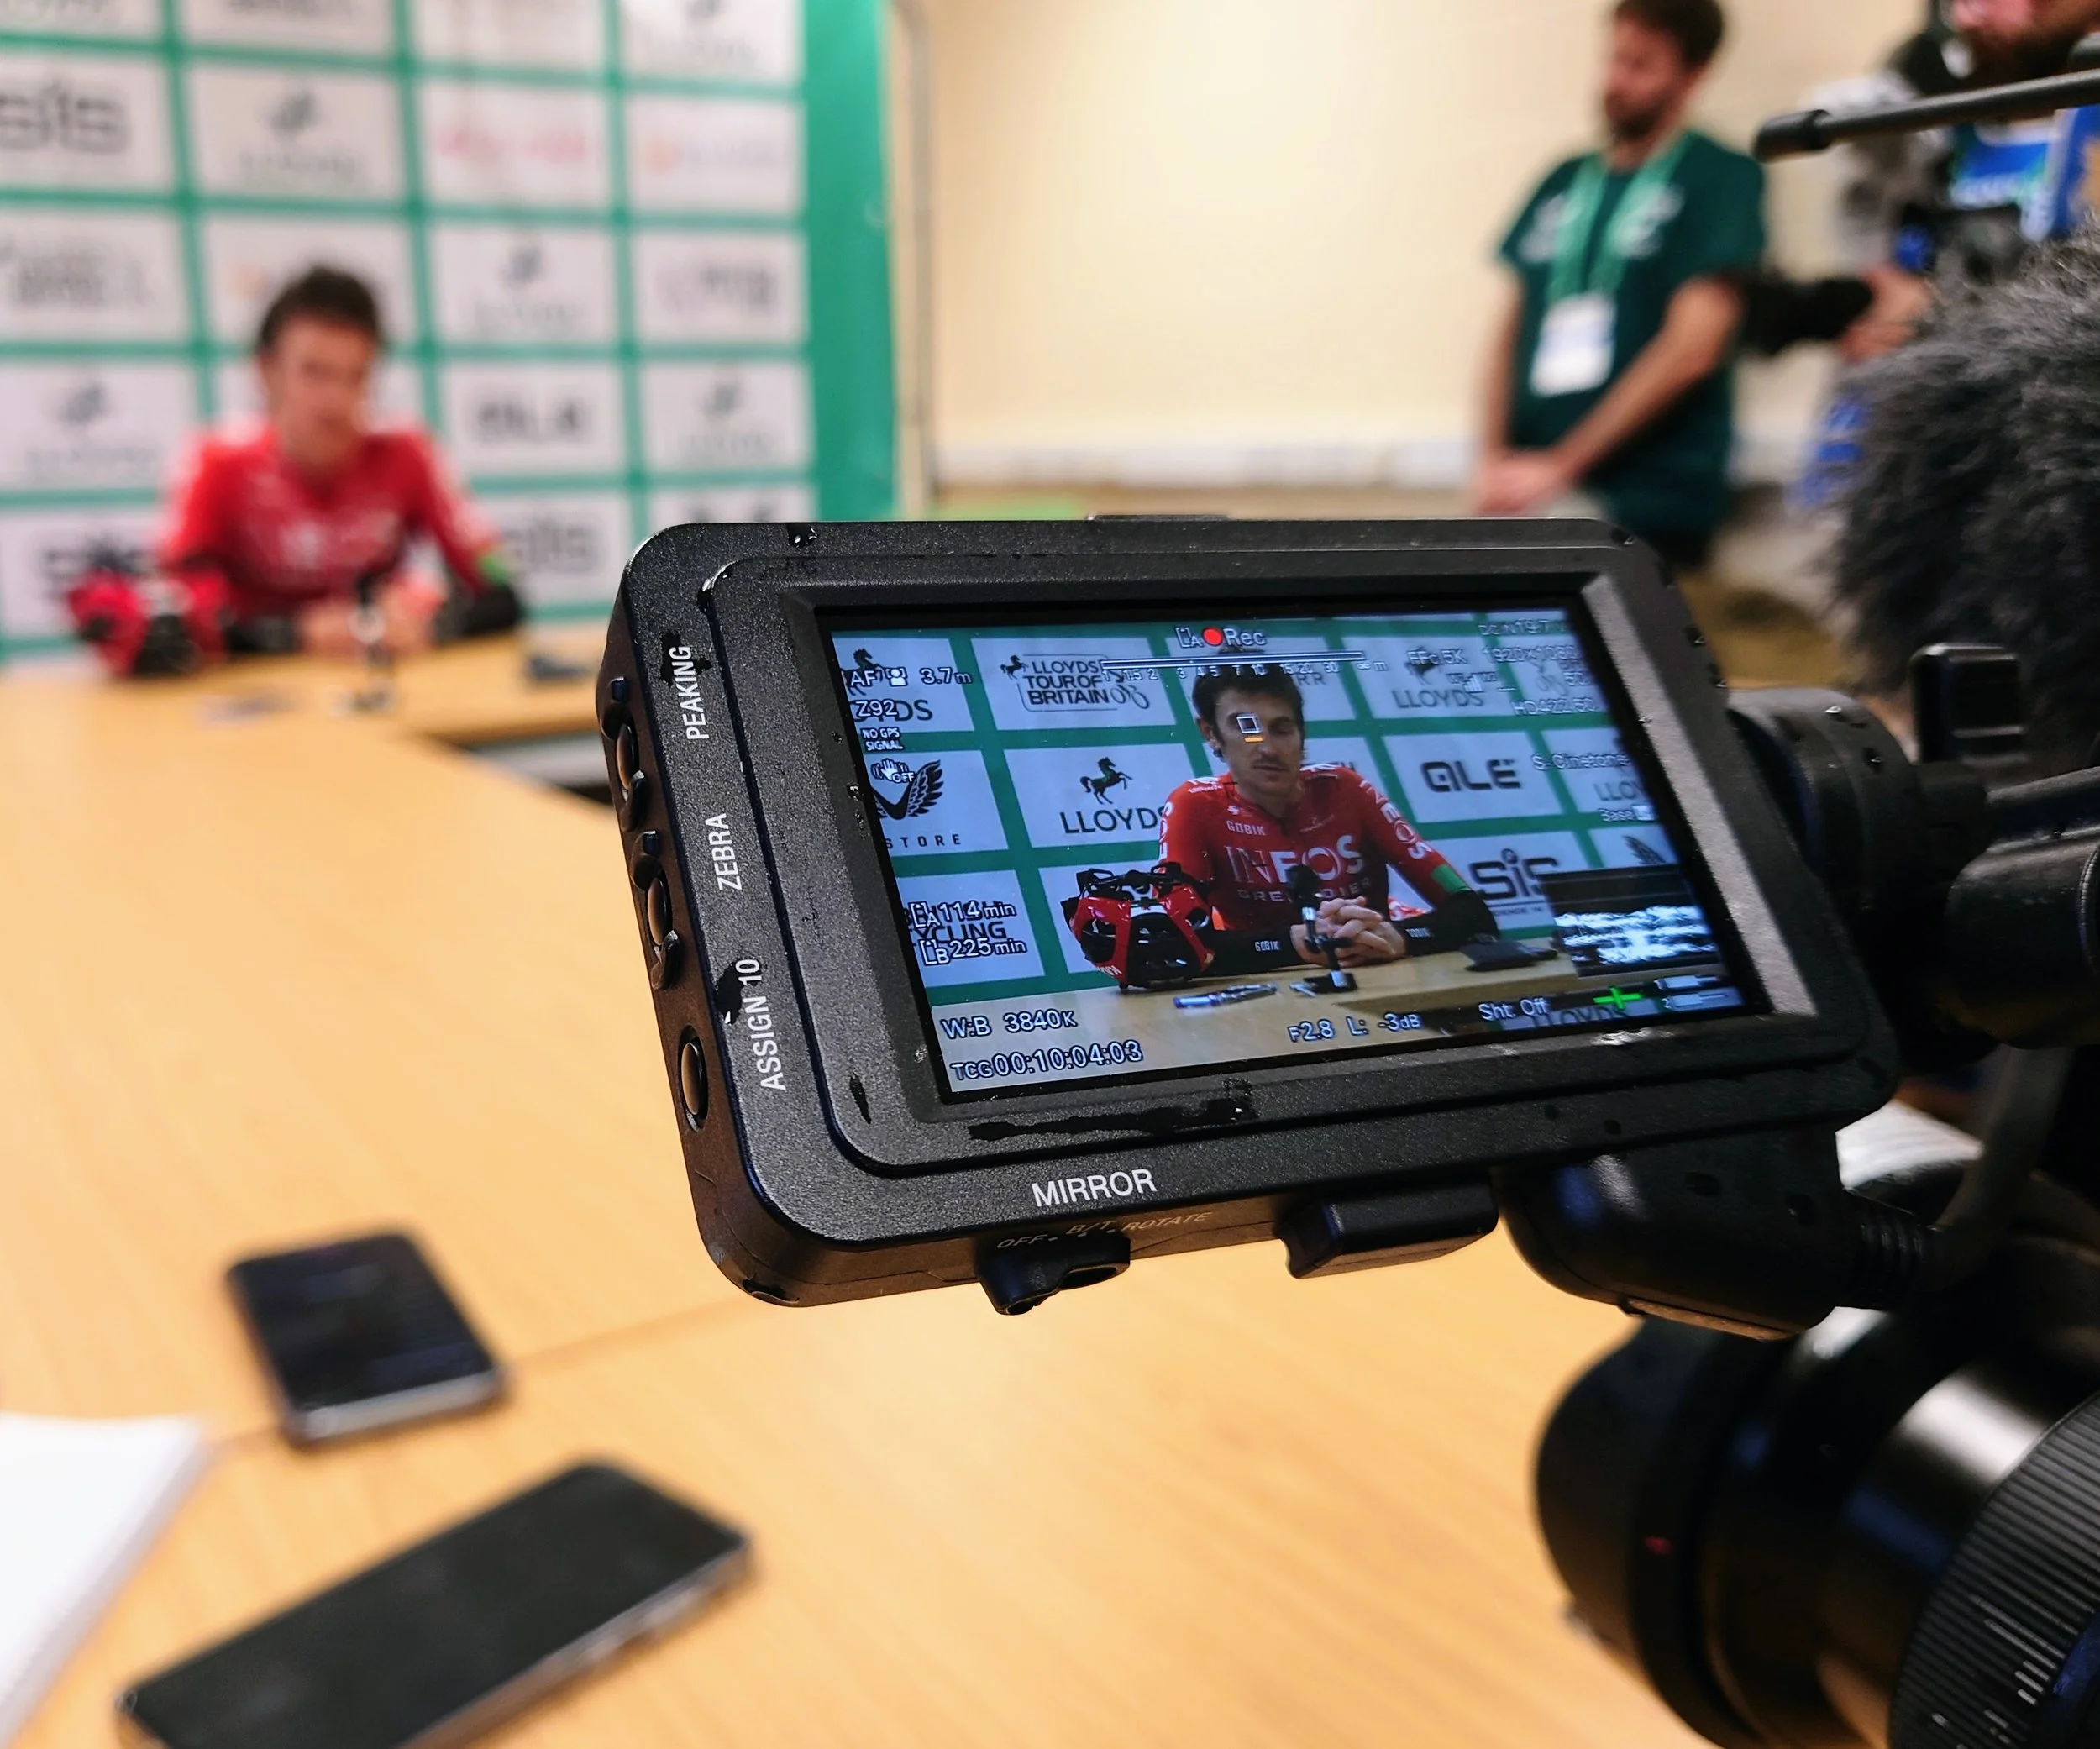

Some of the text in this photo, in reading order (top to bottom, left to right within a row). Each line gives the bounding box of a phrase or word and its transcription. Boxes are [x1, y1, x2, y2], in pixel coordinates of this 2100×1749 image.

[1222, 628, 1266, 647] Rec
[1032, 660, 1099, 675] LLOYDS
[1148, 668, 1158, 680] 2
[1177, 667, 1186, 679] 3
[1210, 666, 1221, 677] 5
[850, 670, 876, 686] AF
[1022, 675, 1103, 689] TOUR OF
[669, 645, 710, 740] PEAKING
[1027, 689, 1110, 705] BRITAIN
[855, 699, 898, 717] Z92
[862, 727, 900, 739] NO GPS
[865, 740, 903, 751] SIGNAL
[892, 772, 915, 783] OFF
[1226, 820, 1267, 837] GOBIK
[885, 833, 962, 849] STORE
[704, 812, 743, 892] ZEBRA
[1224, 834, 1365, 884] INEOS
[735, 959, 786, 1092] ASSIGN 10
[1288, 1019, 1335, 1043] F2.8
[1378, 1012, 1421, 1032] -3dB
[1520, 997, 1548, 1016] Off
[1031, 1169, 1157, 1208] MIRROR
[997, 1211, 1214, 1248] OFF B/T ROTATE
